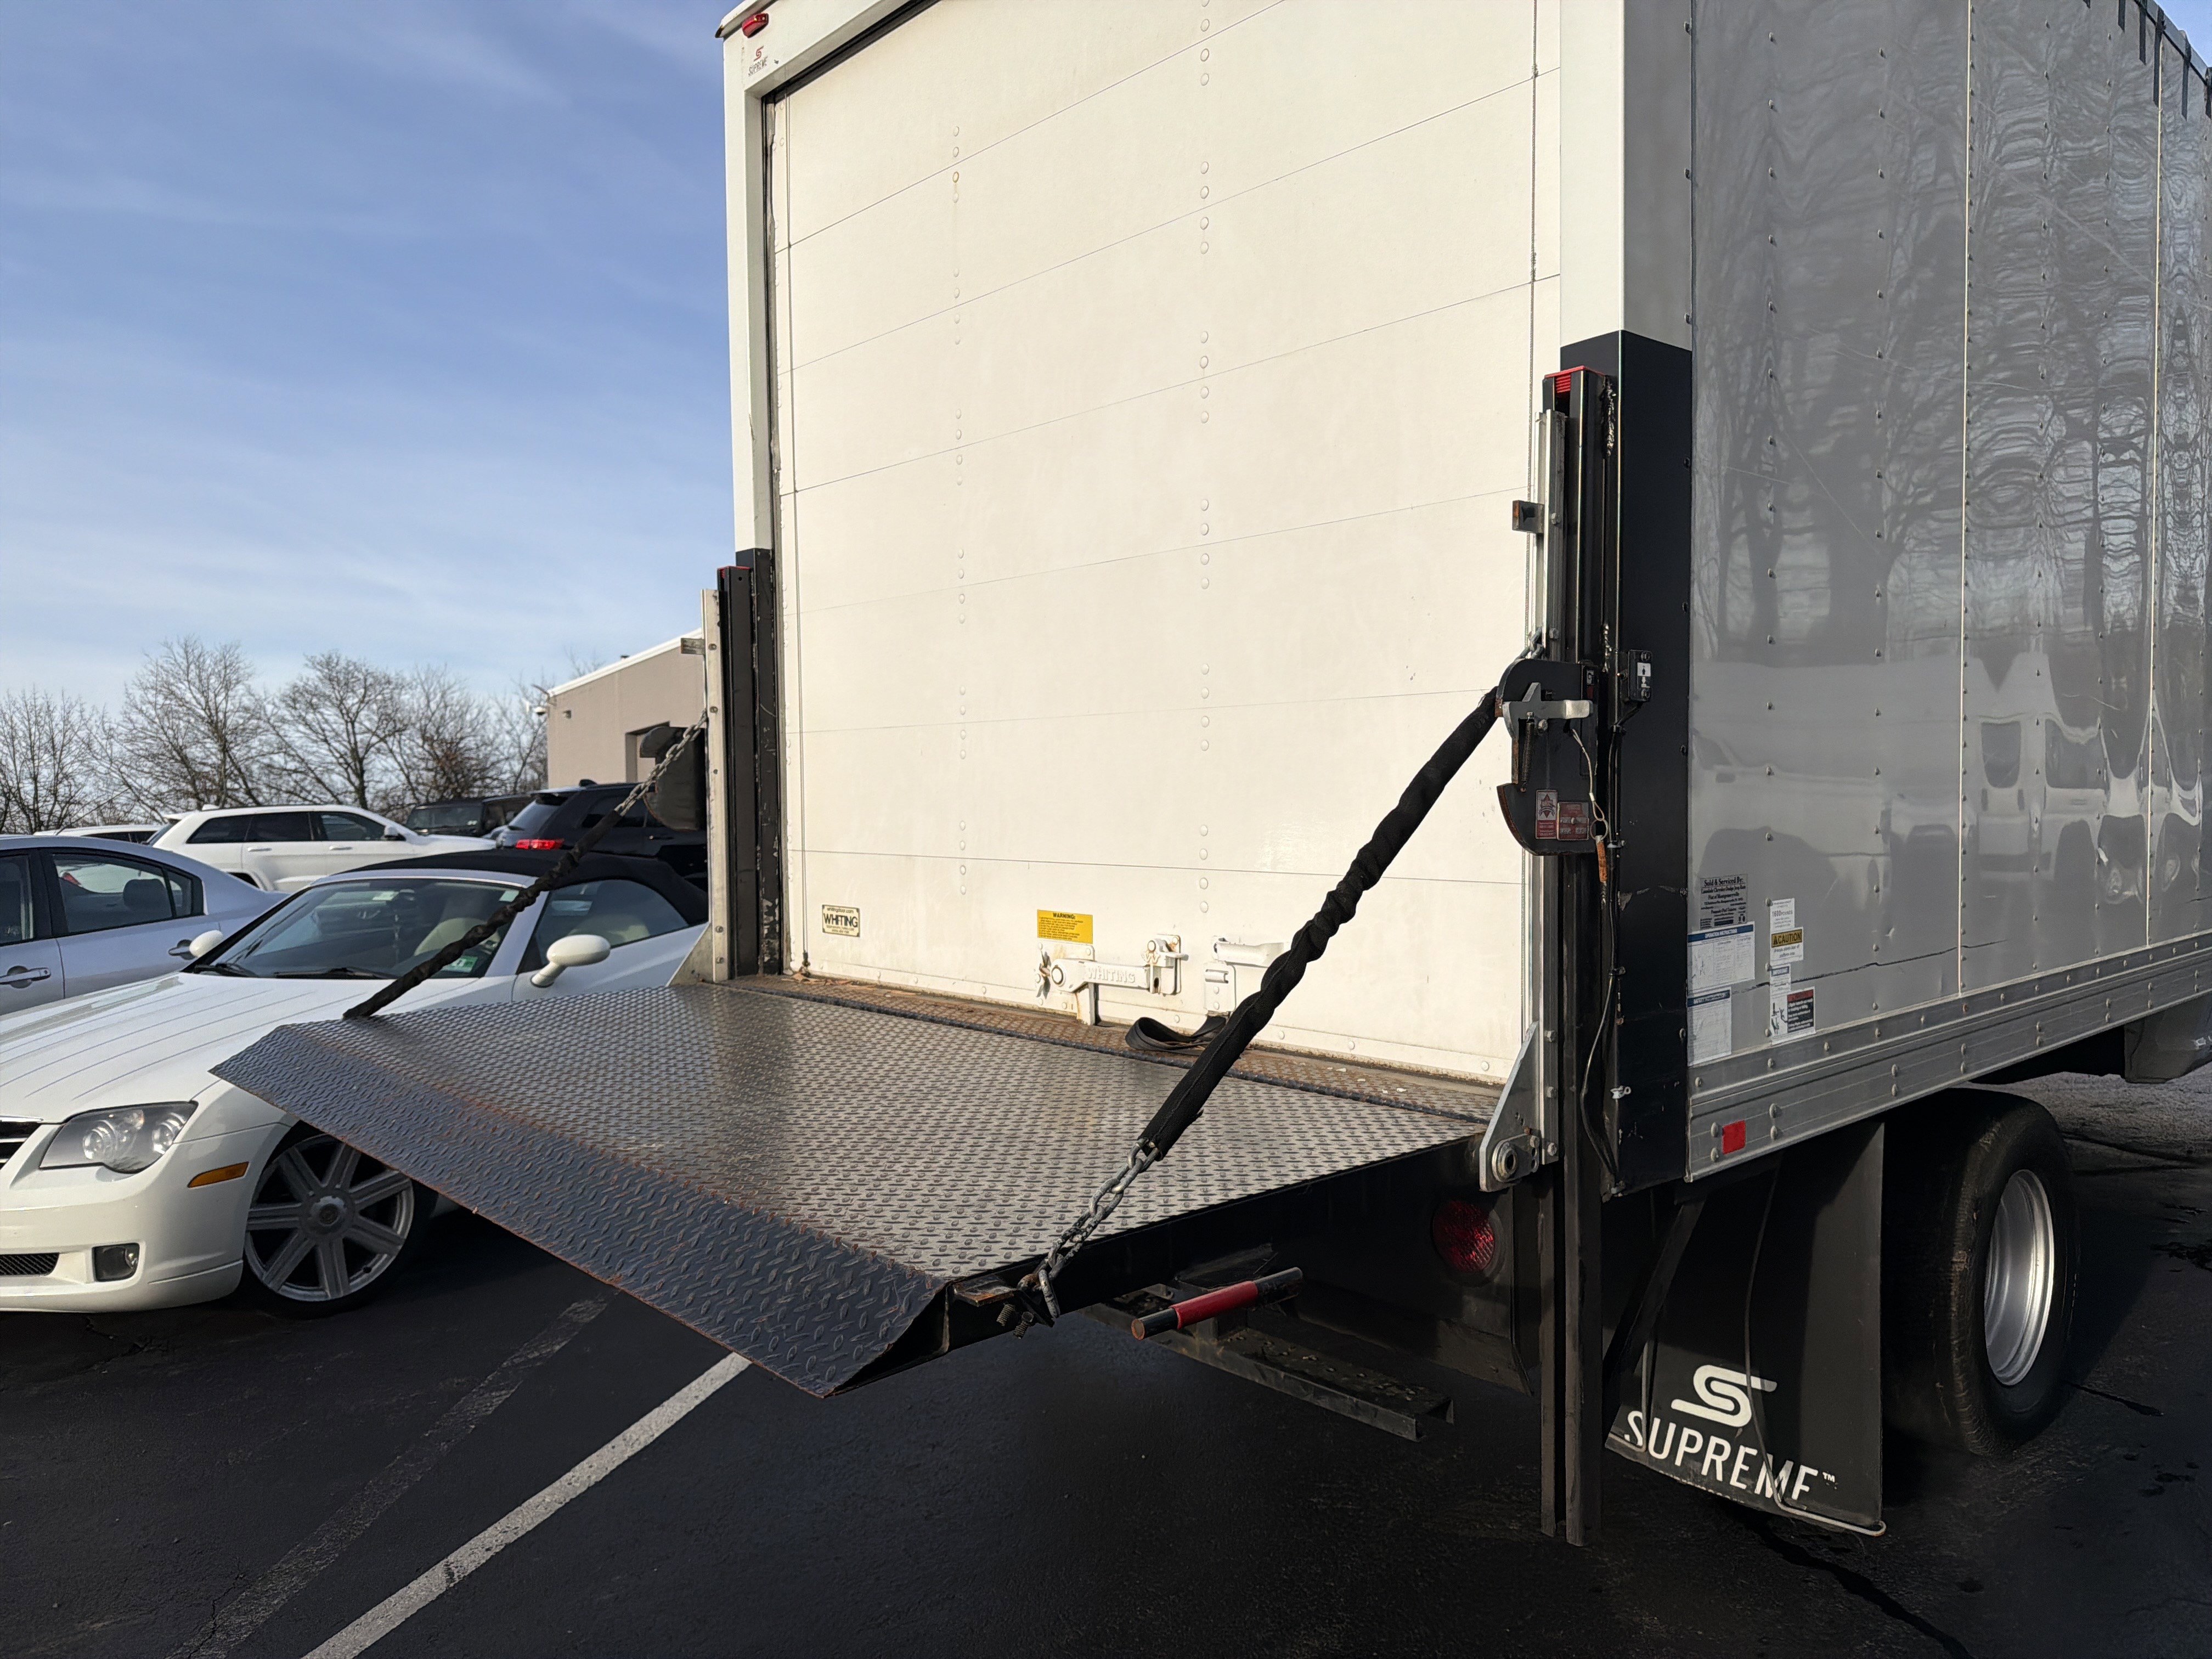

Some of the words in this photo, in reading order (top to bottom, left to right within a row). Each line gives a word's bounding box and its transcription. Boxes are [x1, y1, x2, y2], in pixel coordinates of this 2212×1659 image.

[1719, 877, 1736, 885] Serviced
[823, 912, 858, 928] WHITING
[1778, 932, 1801, 944] CAUTION
[1088, 966, 1136, 983] WHITING
